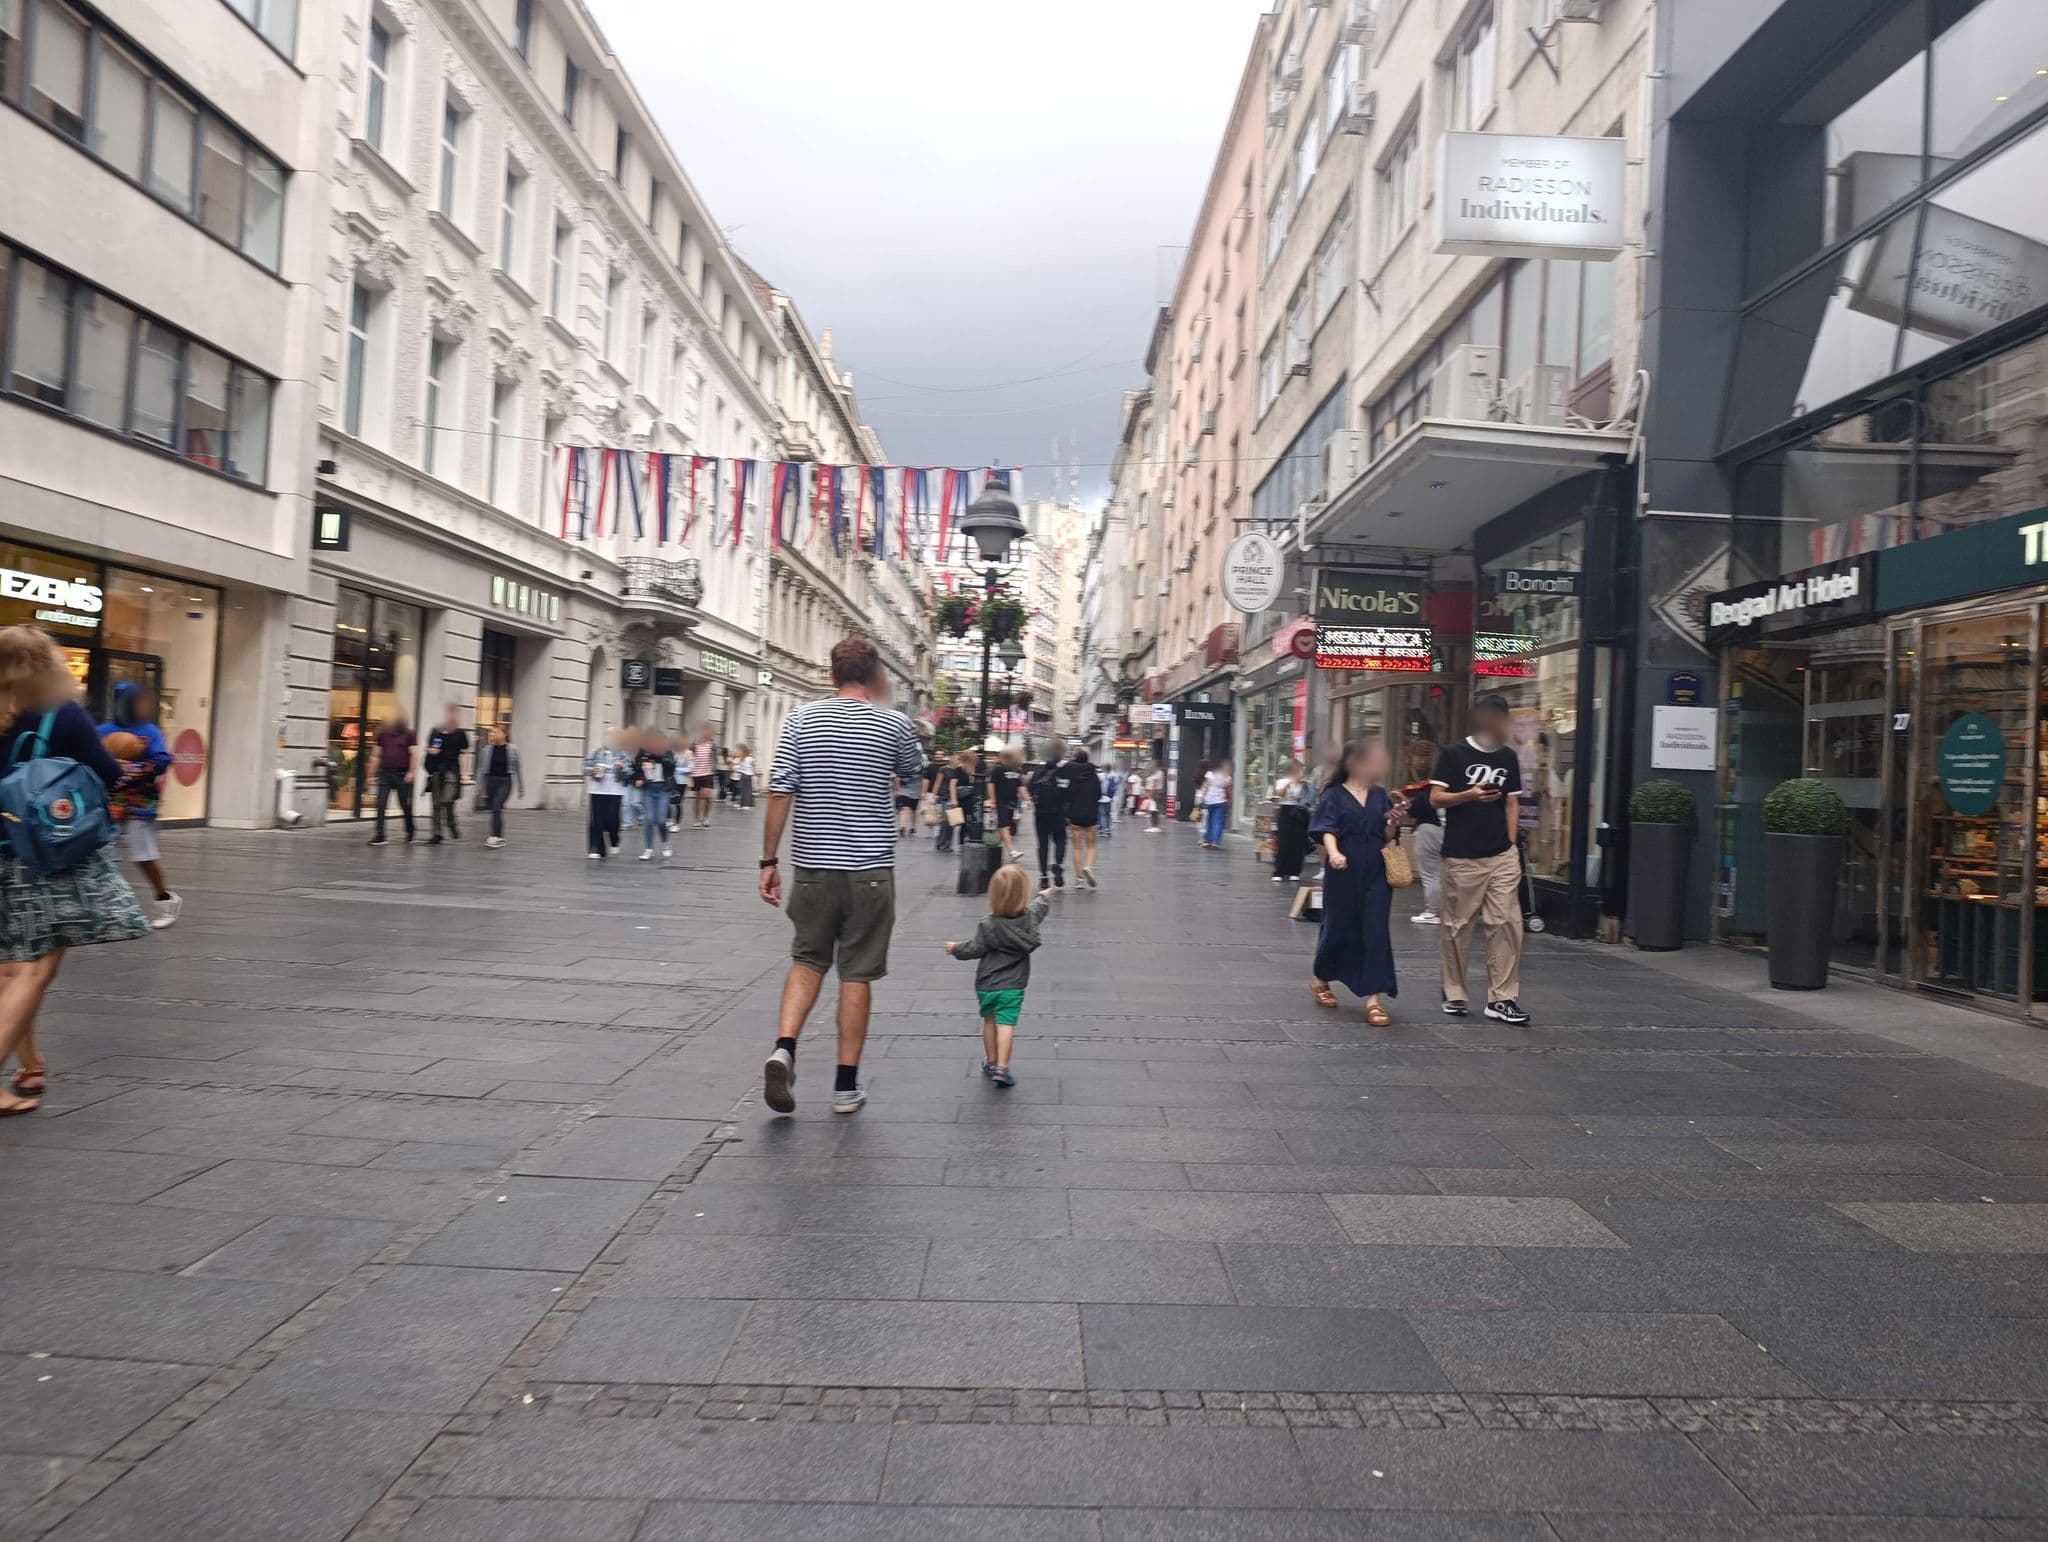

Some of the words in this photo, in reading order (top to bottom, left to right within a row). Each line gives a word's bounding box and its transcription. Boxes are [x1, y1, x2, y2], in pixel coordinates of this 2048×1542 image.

[1502, 158, 1550, 169] MEMBER
[1553, 159, 1572, 170] OF
[1479, 176, 1593, 196] RADISSON
[1460, 198, 1608, 224] Individuals.
[1231, 566, 1273, 576] PRINCE
[1235, 575, 1267, 585] HALL
[0, 567, 103, 613] EZENIS
[1710, 588, 1777, 627] Beograd
[1776, 582, 1806, 612] Art
[1806, 567, 1860, 606] Hotel
